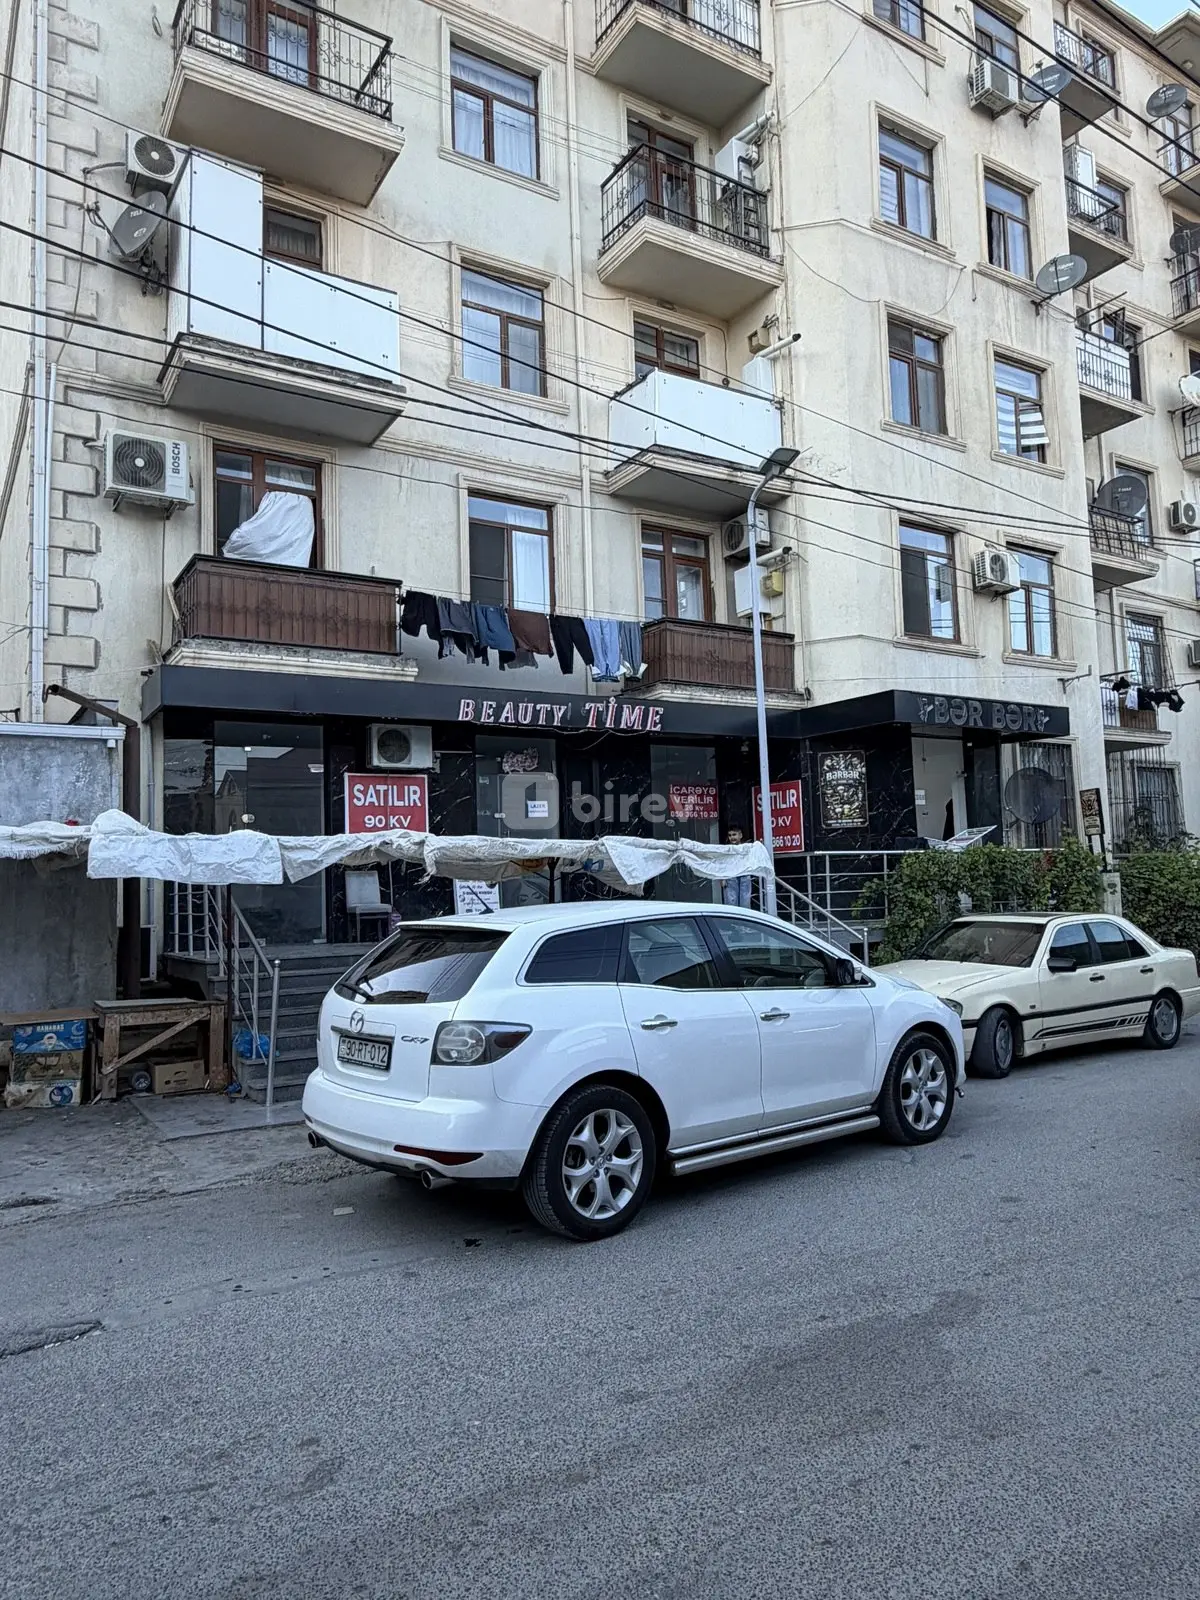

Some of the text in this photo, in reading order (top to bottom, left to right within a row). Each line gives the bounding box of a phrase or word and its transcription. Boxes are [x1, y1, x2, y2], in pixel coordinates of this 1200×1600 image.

[172, 442, 181, 475] BOSCH
[458, 697, 664, 731] BEAUTY TİME
[934, 697, 1037, 732] BƏR BƏR
[353, 784, 421, 807] SATILIR
[670, 784, 716, 795] İCARƏYƏ
[673, 795, 714, 804] VERİLİR
[757, 789, 798, 811] STILIR
[364, 815, 412, 828] 90 KV
[700, 811, 709, 819] 10
[778, 815, 792, 827] KV
[772, 836, 783, 848] 366
[784, 835, 792, 847] 10
[792, 834, 801, 846] 20
[401, 1035, 430, 1045] CX-7
[346, 1040, 388, 1064] 90-RT-012
